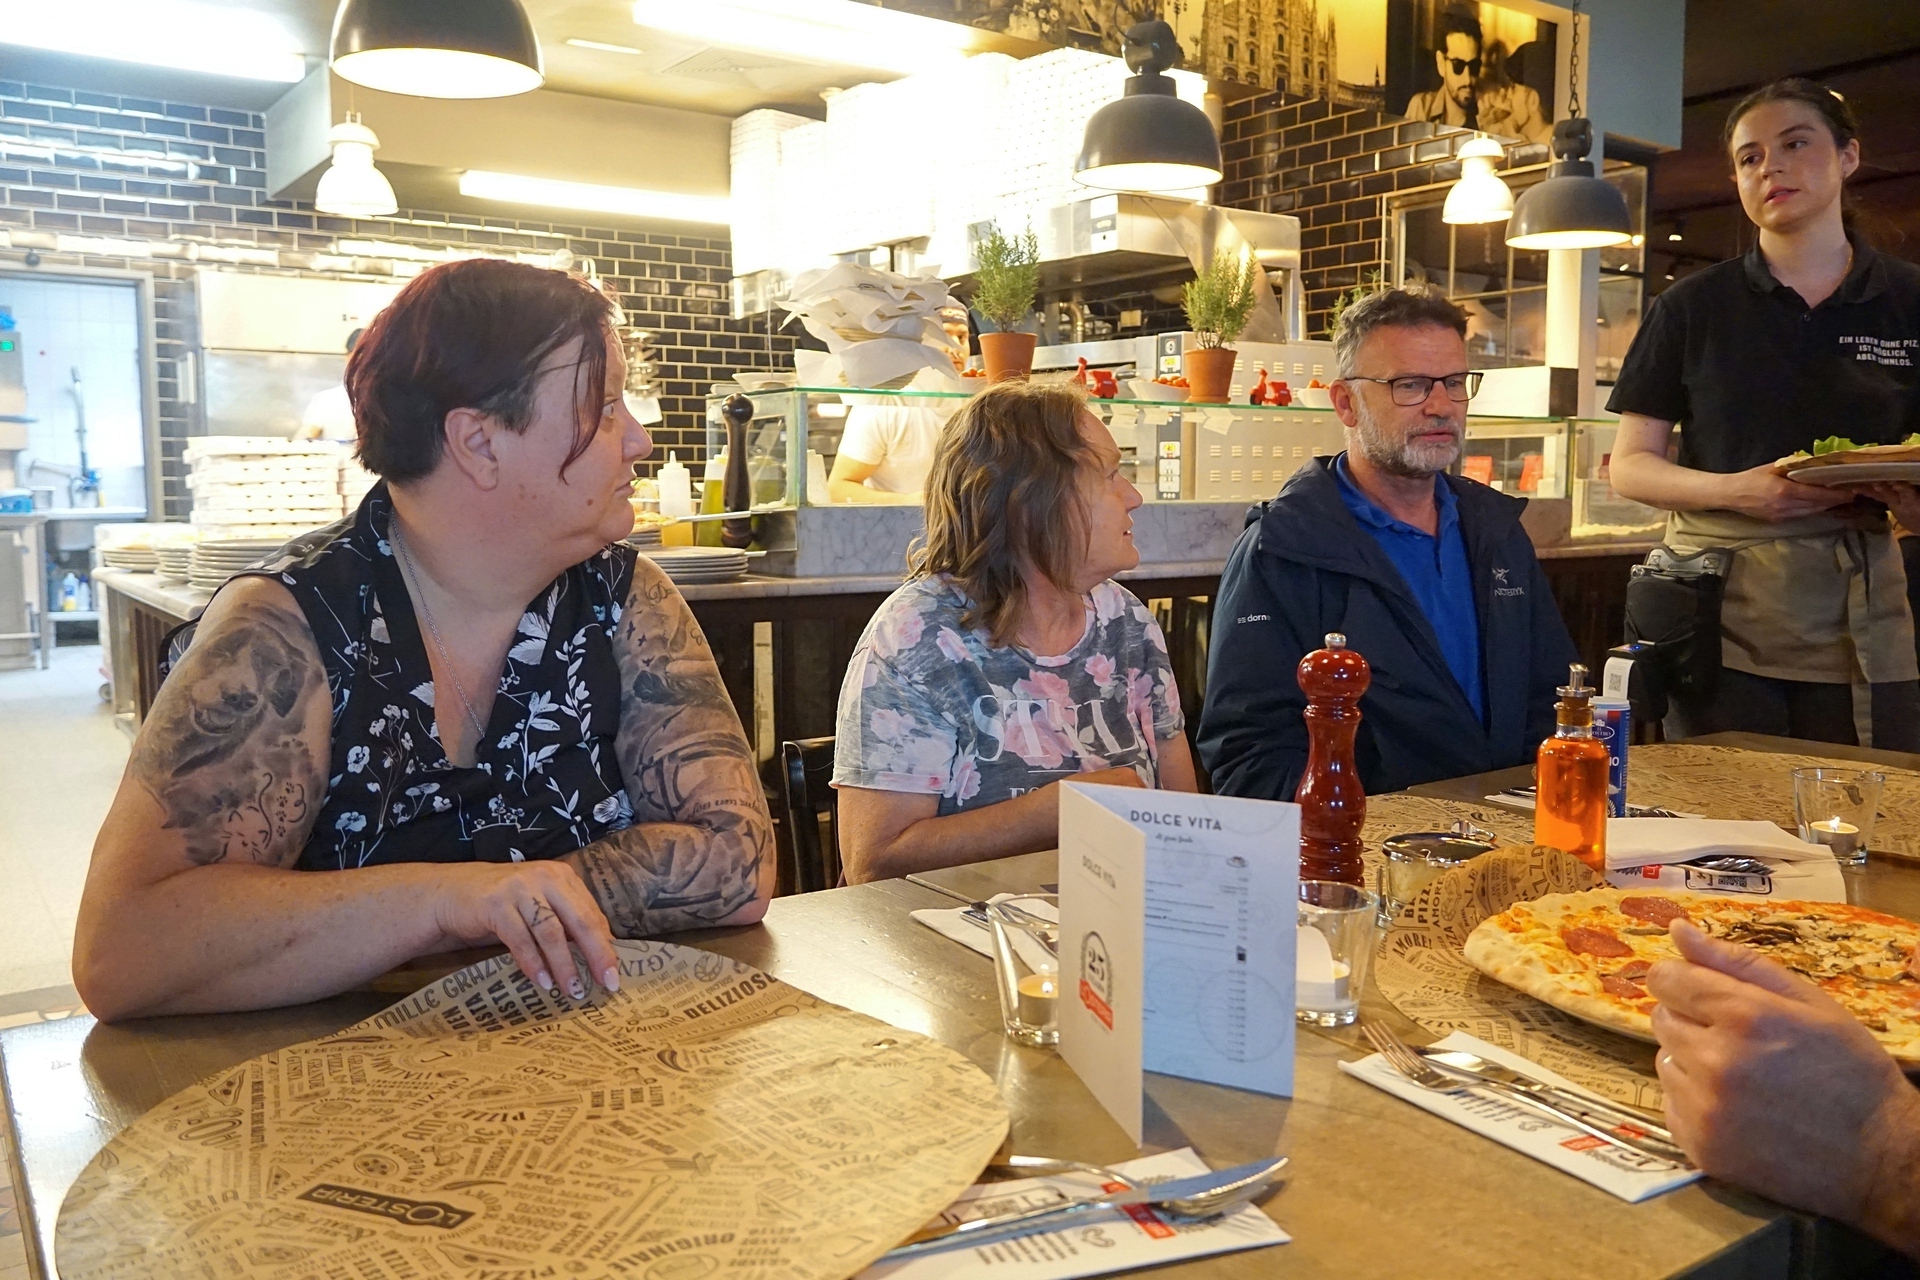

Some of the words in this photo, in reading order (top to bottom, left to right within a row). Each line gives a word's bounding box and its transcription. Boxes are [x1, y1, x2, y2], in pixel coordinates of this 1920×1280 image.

[1855, 336, 1878, 345] LEBEN
[1880, 340, 1901, 348] OHNE
[1903, 340, 1920, 348] PIZ
[1856, 353, 1877, 361] ABER
[1131, 810, 1182, 827] DOLCE
[1187, 816, 1222, 831] VITA
[1392, 932, 1433, 959] AMORE!
[373, 988, 441, 1030] MILLE
[441, 1005, 471, 1030] DEN
